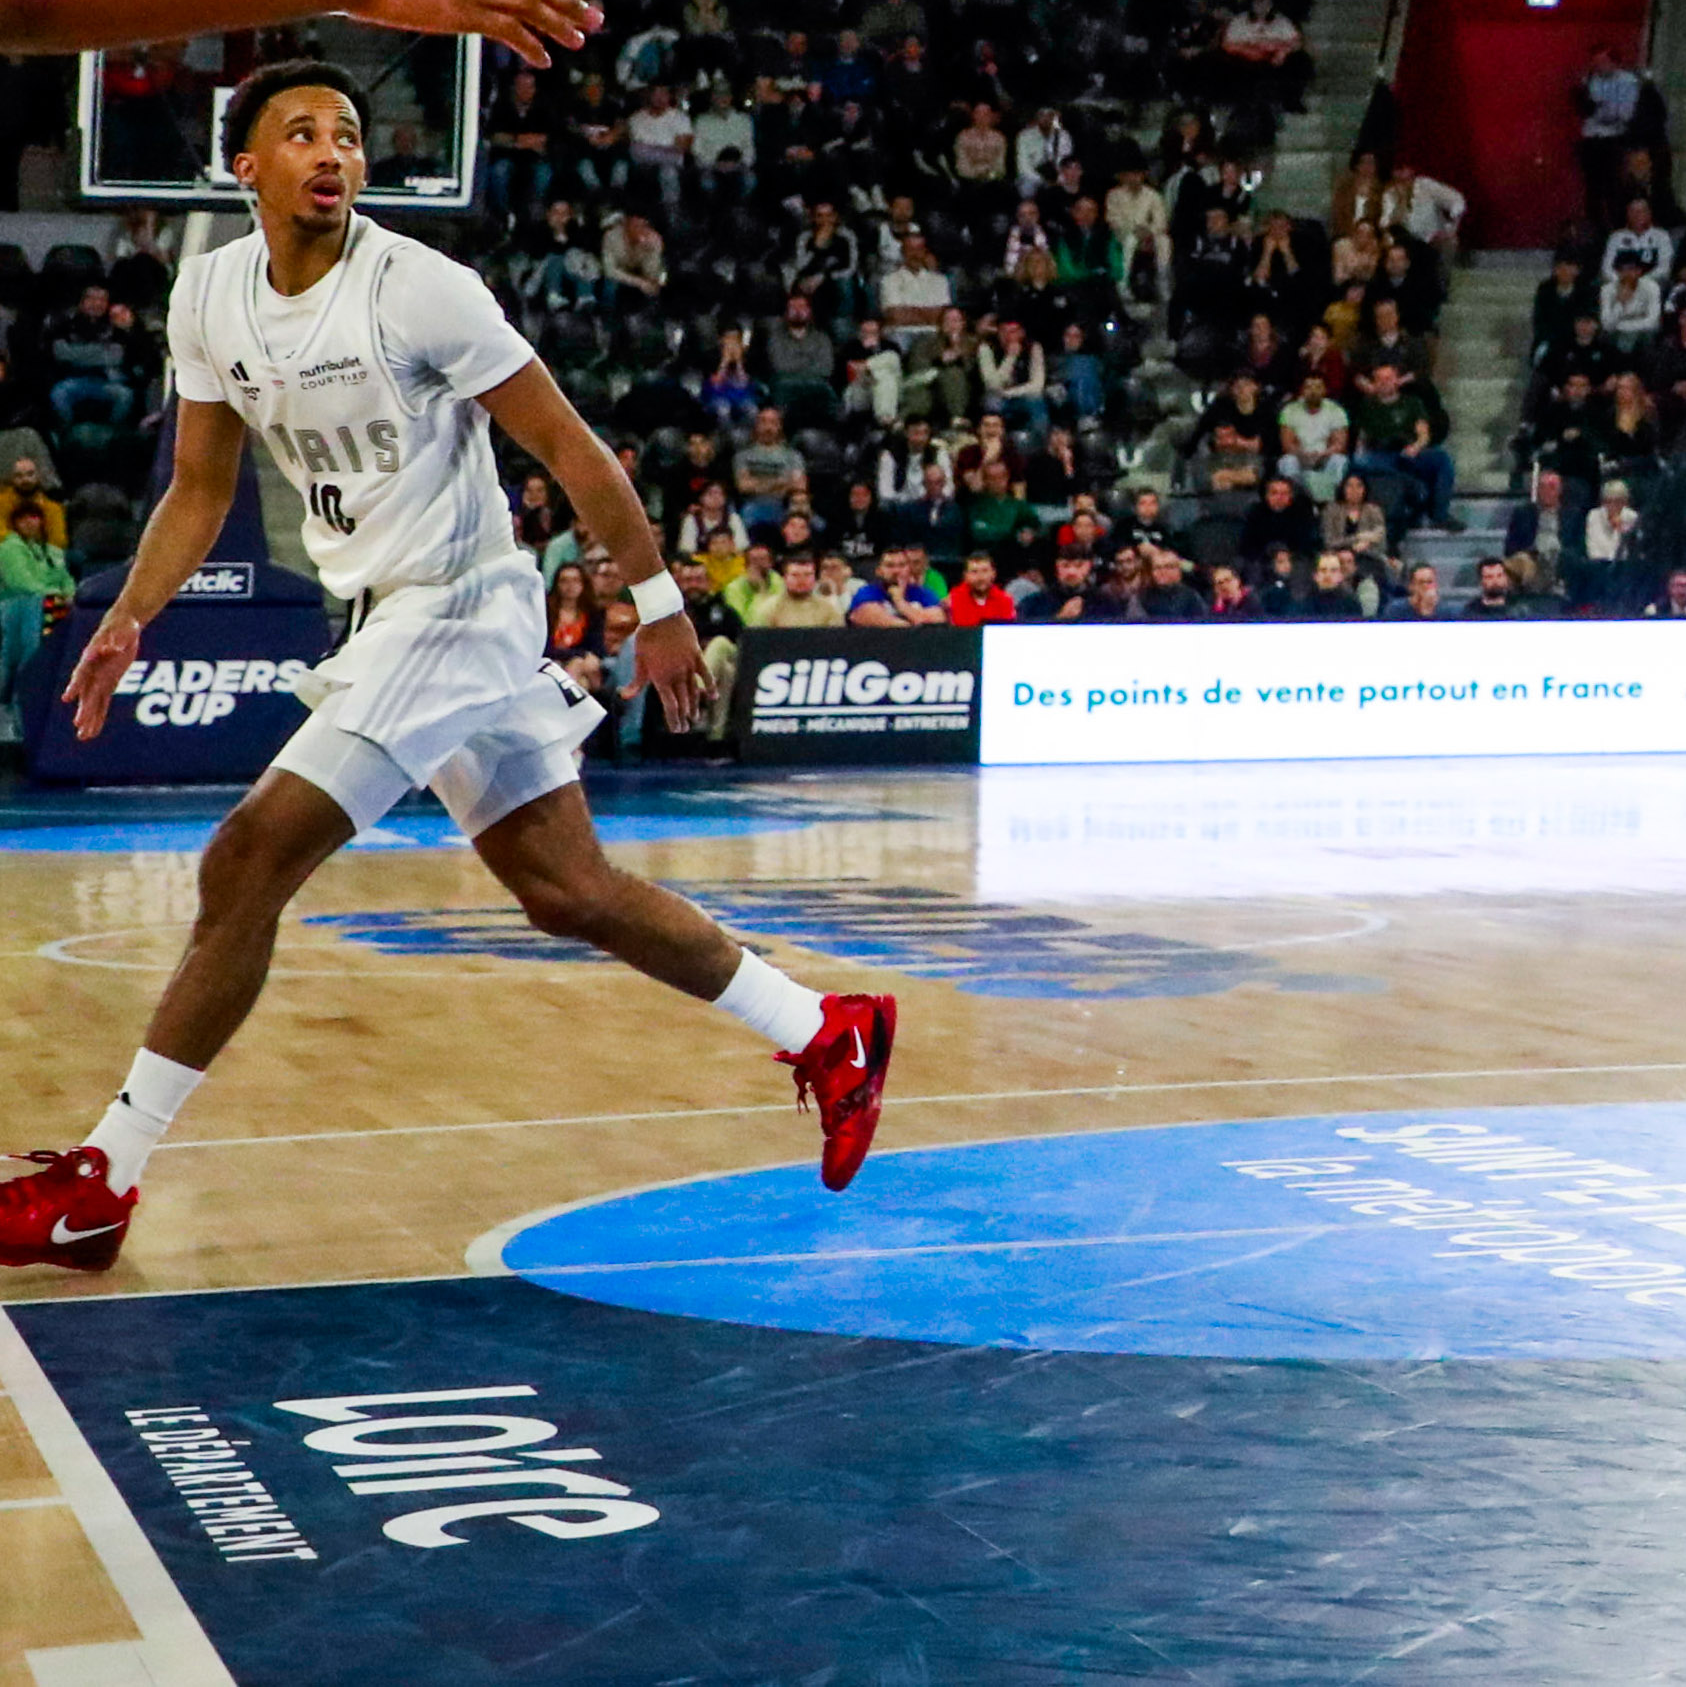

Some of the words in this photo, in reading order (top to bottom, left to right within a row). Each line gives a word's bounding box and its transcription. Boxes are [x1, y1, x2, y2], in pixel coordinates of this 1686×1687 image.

[113, 659, 304, 694] EADERS
[754, 658, 975, 706] SiliGom
[1013, 682, 1073, 707] Des
[1087, 679, 1189, 714] points
[1203, 678, 1243, 705] de
[1256, 681, 1345, 705] vente
[1359, 679, 1480, 710] partout
[1493, 684, 1528, 701] en
[1543, 675, 1644, 700] France
[136, 693, 236, 726] CUP
[124, 1406, 210, 1427] LE
[139, 1427, 320, 1563] DÉPARTEMENT
